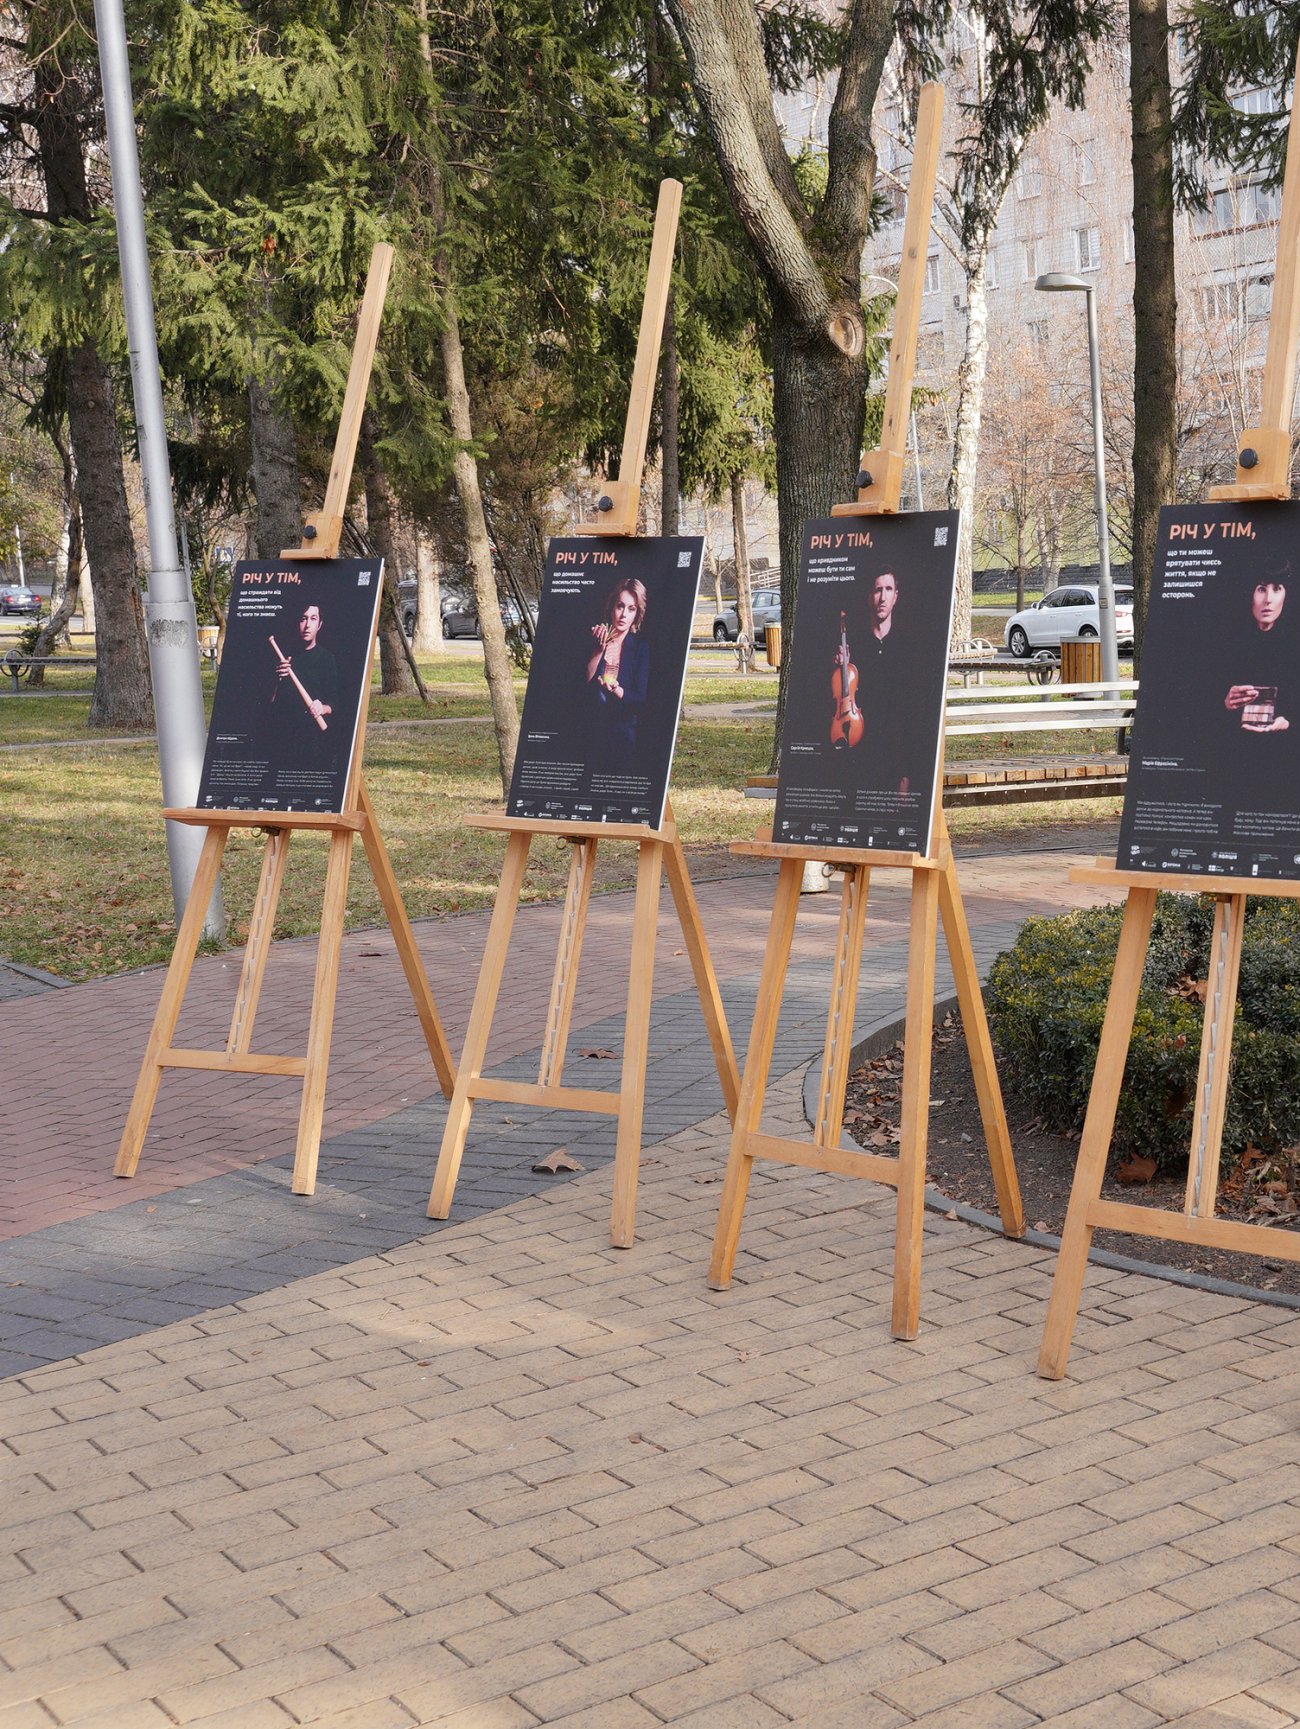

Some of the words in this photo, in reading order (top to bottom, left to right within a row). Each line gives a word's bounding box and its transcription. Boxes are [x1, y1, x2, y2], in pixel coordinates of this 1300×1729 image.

[1169, 523, 1199, 540] РІЧ
[1203, 523, 1216, 539] У
[1220, 521, 1257, 540] ТІМ,
[810, 534, 832, 549] РІЧ
[834, 534, 844, 548] У
[847, 532, 873, 549] ТІМ,
[555, 552, 577, 564] РІЧ
[579, 552, 590, 564] У
[592, 551, 618, 566] ТІМ,
[1166, 560, 1201, 568] врятувати
[242, 572, 263, 584] РІЧ
[265, 572, 274, 584] У
[276, 572, 301, 585] ТІМ,
[1164, 570, 1187, 578] життя,
